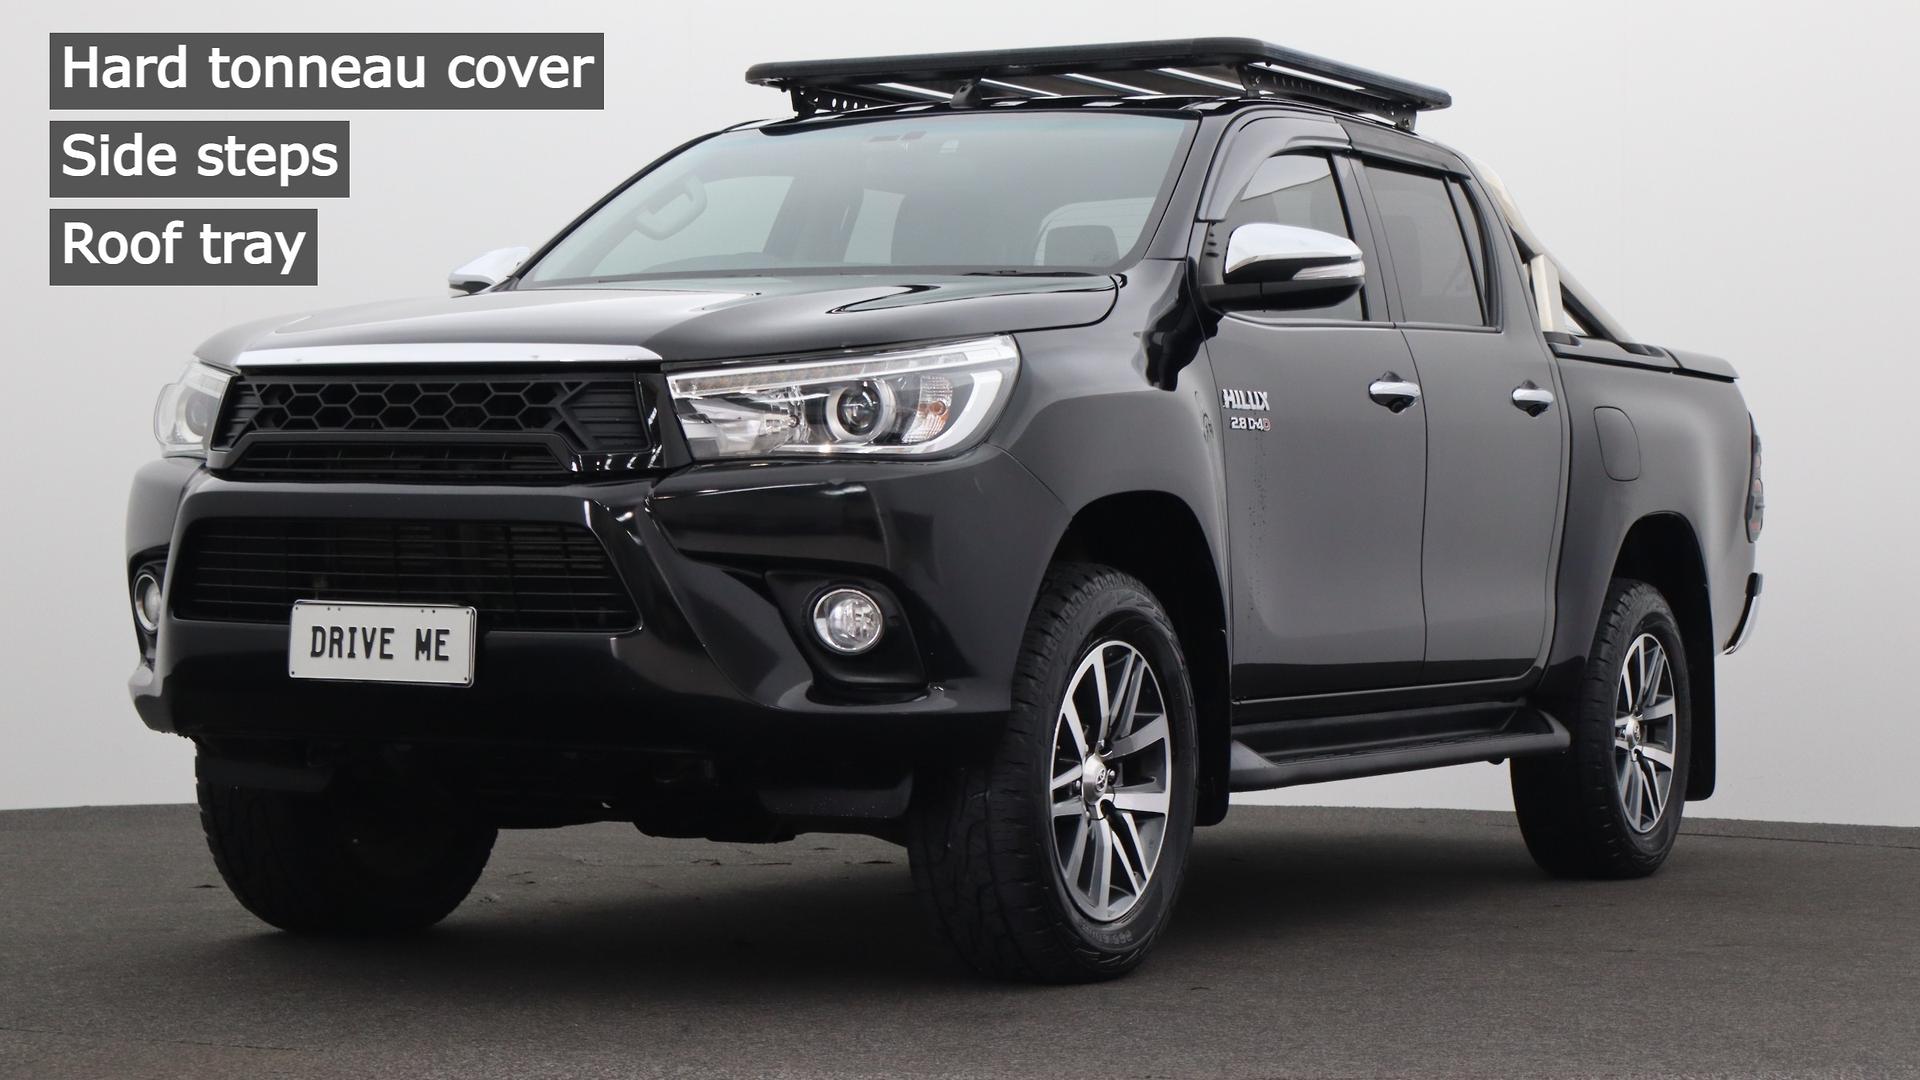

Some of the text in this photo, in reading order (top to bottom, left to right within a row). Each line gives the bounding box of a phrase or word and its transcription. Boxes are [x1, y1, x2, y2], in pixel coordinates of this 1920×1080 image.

[1222, 389, 1270, 411] HILUX
[310, 626, 450, 661] DRIVE ME
